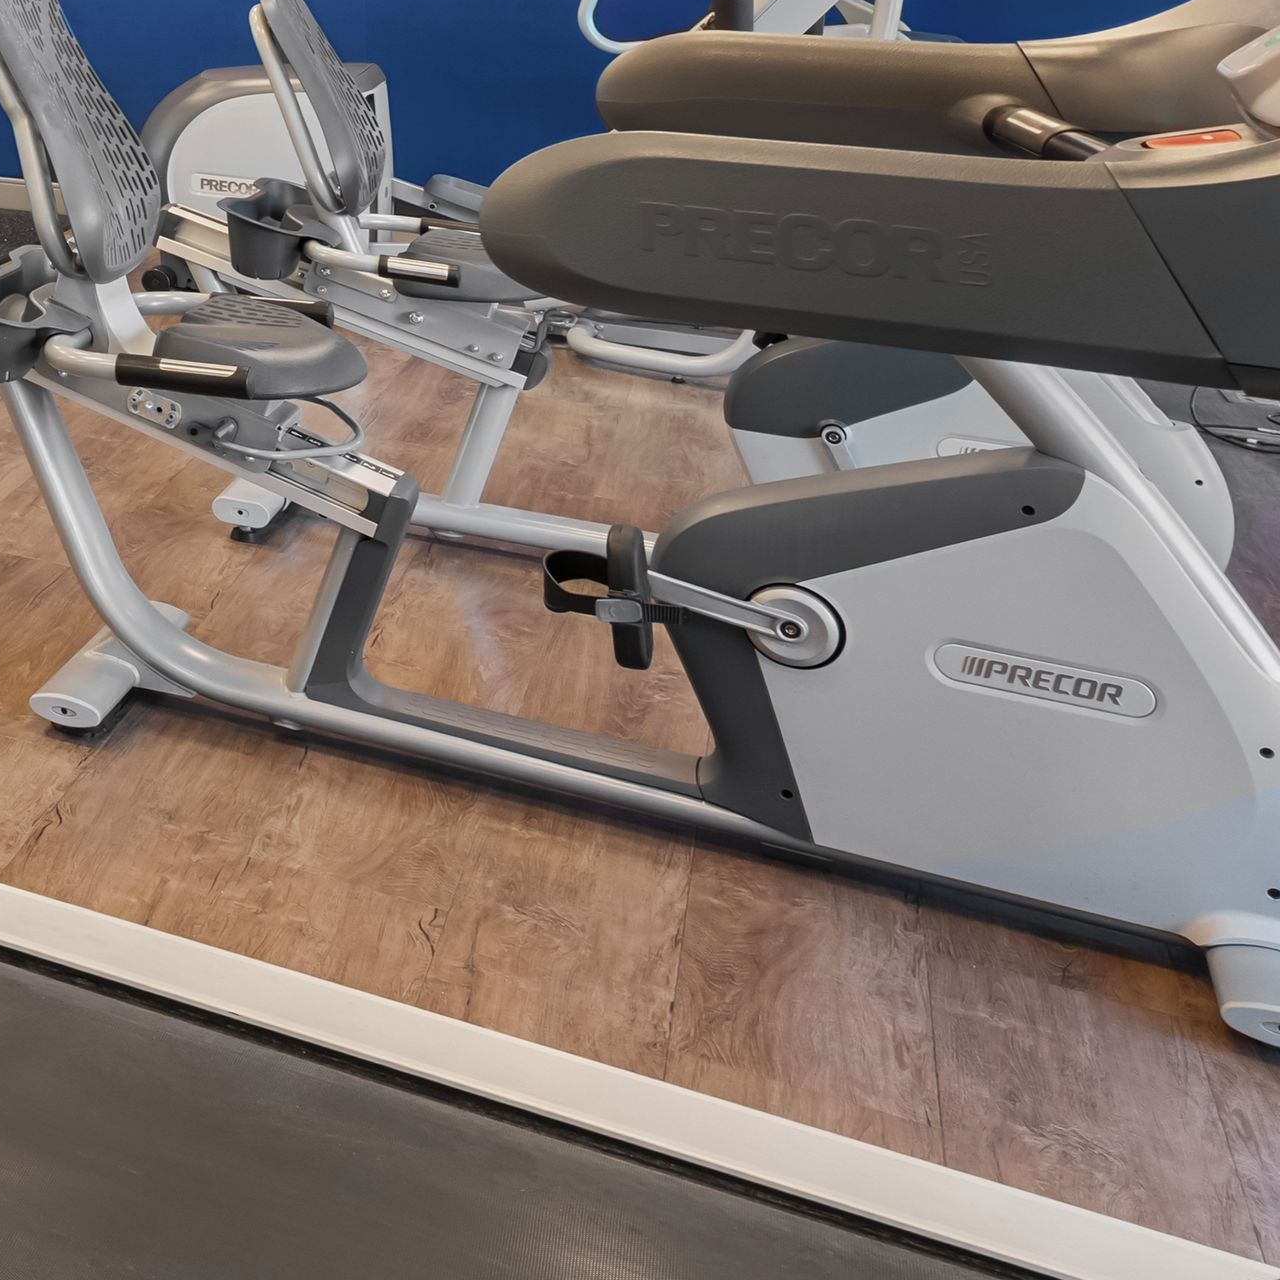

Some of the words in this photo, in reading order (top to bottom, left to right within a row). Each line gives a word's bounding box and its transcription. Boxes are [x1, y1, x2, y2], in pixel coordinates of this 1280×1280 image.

[639, 200, 951, 284] PRECOR
[957, 231, 994, 288] USA
[982, 658, 1124, 706] PRECOR
